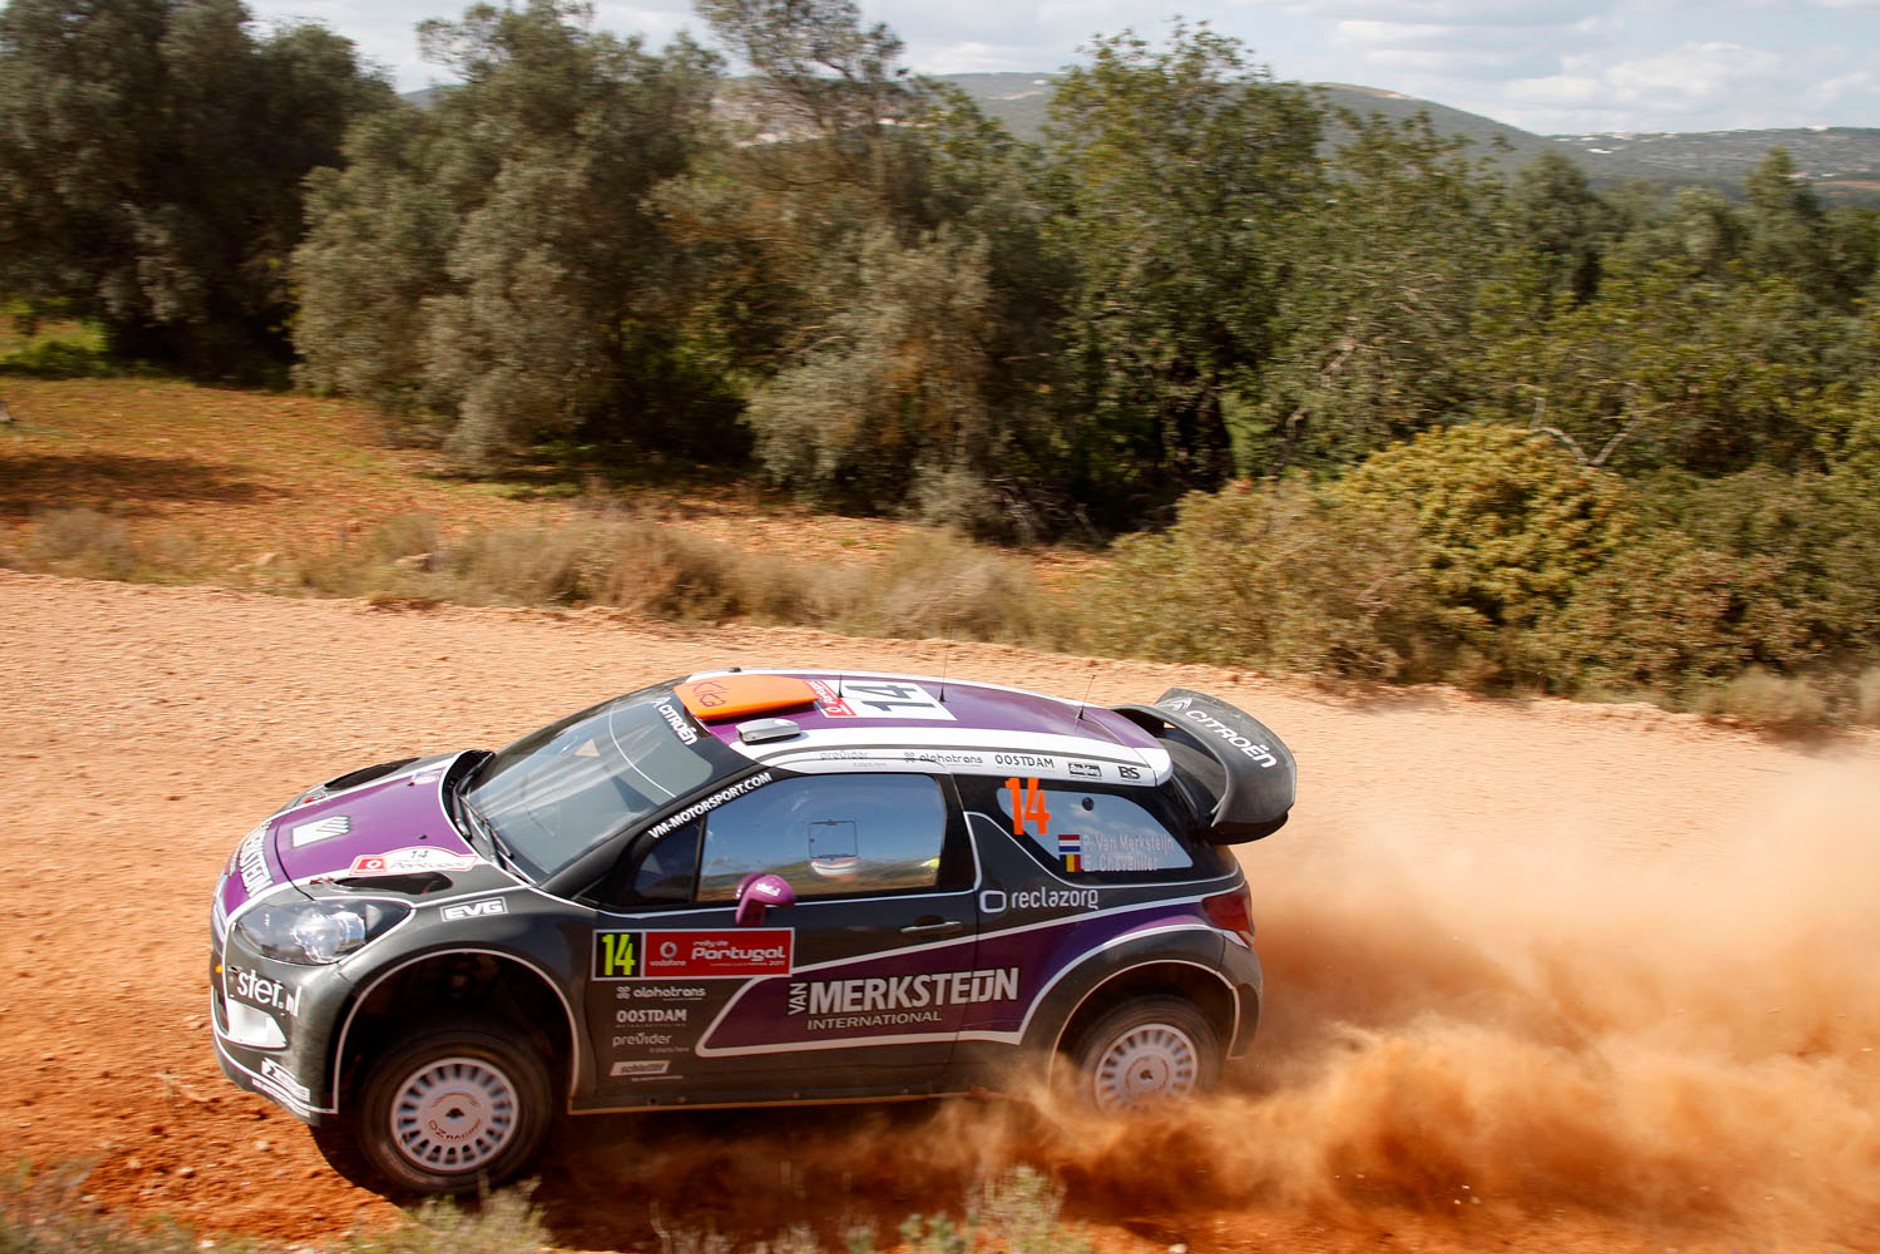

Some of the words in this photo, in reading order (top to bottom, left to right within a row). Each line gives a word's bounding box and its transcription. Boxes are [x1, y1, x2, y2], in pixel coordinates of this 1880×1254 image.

[845, 684, 936, 712] 14
[994, 754, 1055, 768] OOSTDAM
[648, 772, 772, 839] VM-MOTORSPORT.COM
[1005, 777, 1051, 835] 14
[1011, 887, 1099, 909] reclazorg
[444, 900, 503, 920] EVG
[602, 934, 636, 976] 14
[691, 946, 786, 962] Portugal
[633, 986, 706, 998] alphatrans
[788, 982, 808, 1015] VAN
[809, 967, 1019, 1014] MERKSTEIJN
[616, 1009, 687, 1023] OOSTDAM
[807, 1011, 943, 1031] INTERNATIONAL
